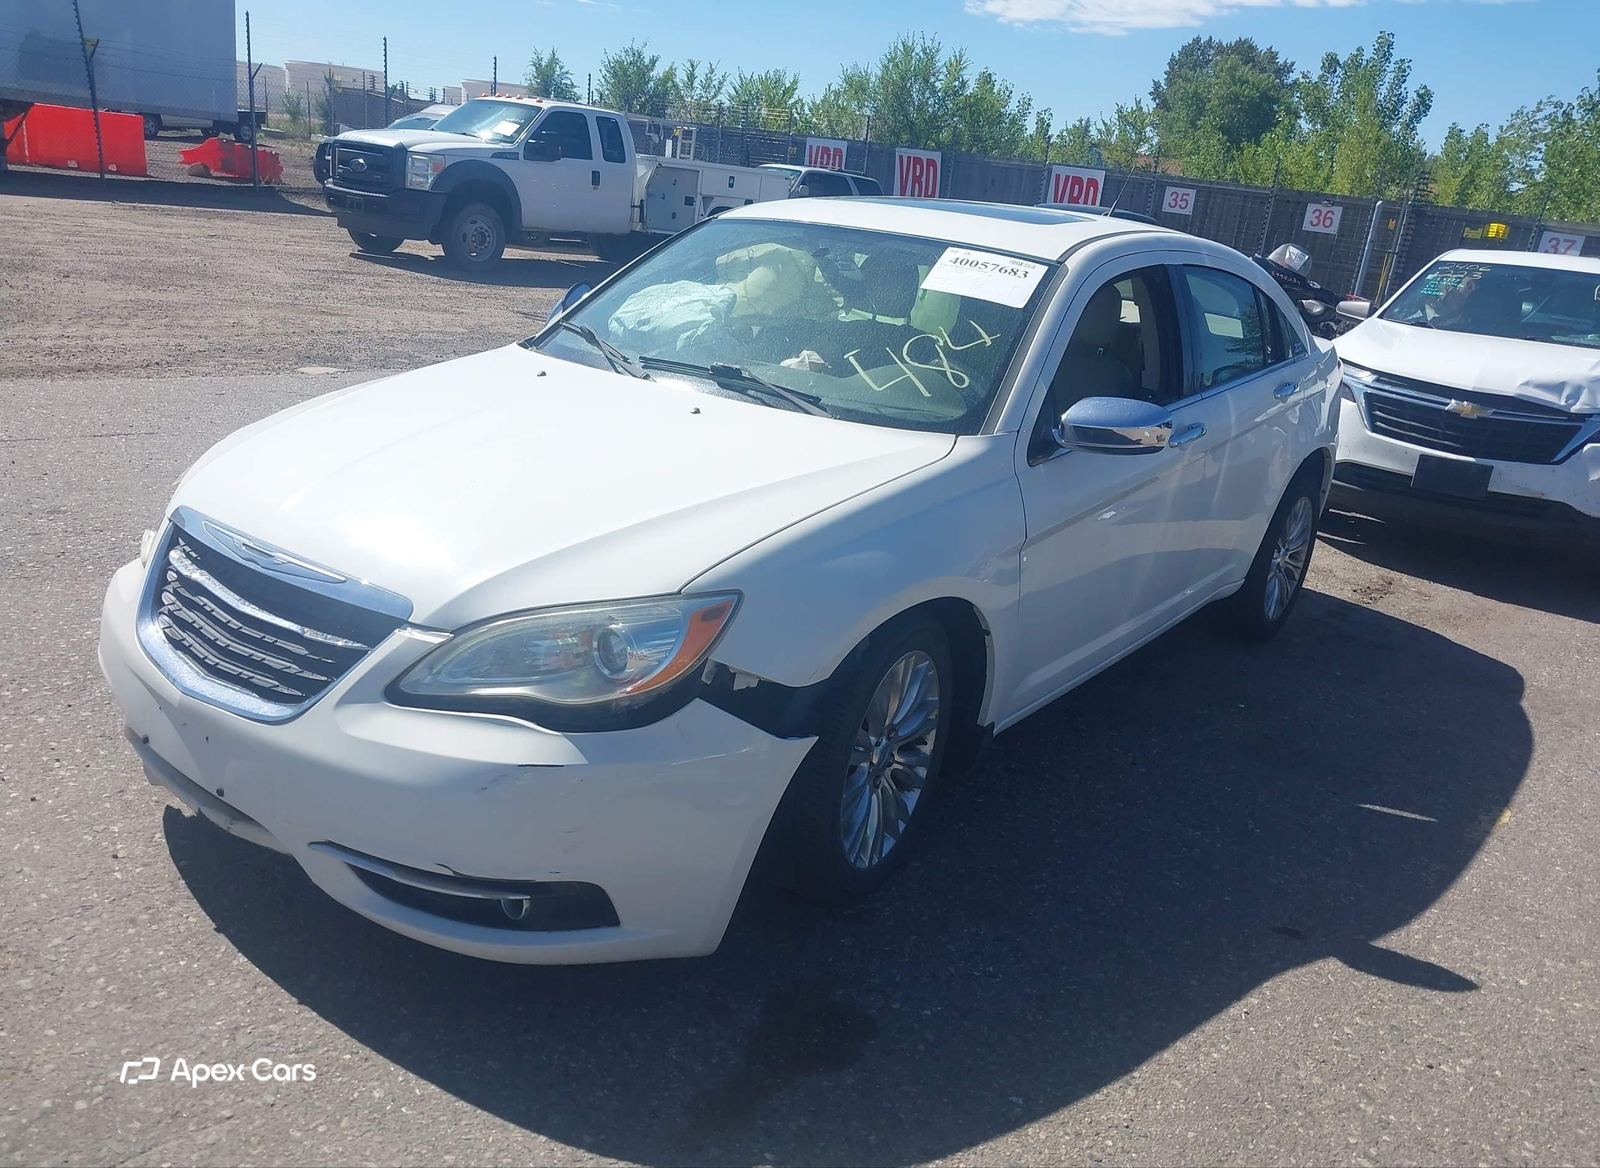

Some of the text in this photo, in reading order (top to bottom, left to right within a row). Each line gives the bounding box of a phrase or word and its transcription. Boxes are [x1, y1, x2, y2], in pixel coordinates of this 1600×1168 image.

[898, 154, 938, 198] VRD
[1168, 191, 1190, 210] 35
[1309, 208, 1336, 229] 36
[1544, 237, 1577, 255] 37
[949, 256, 1029, 279] 40057683
